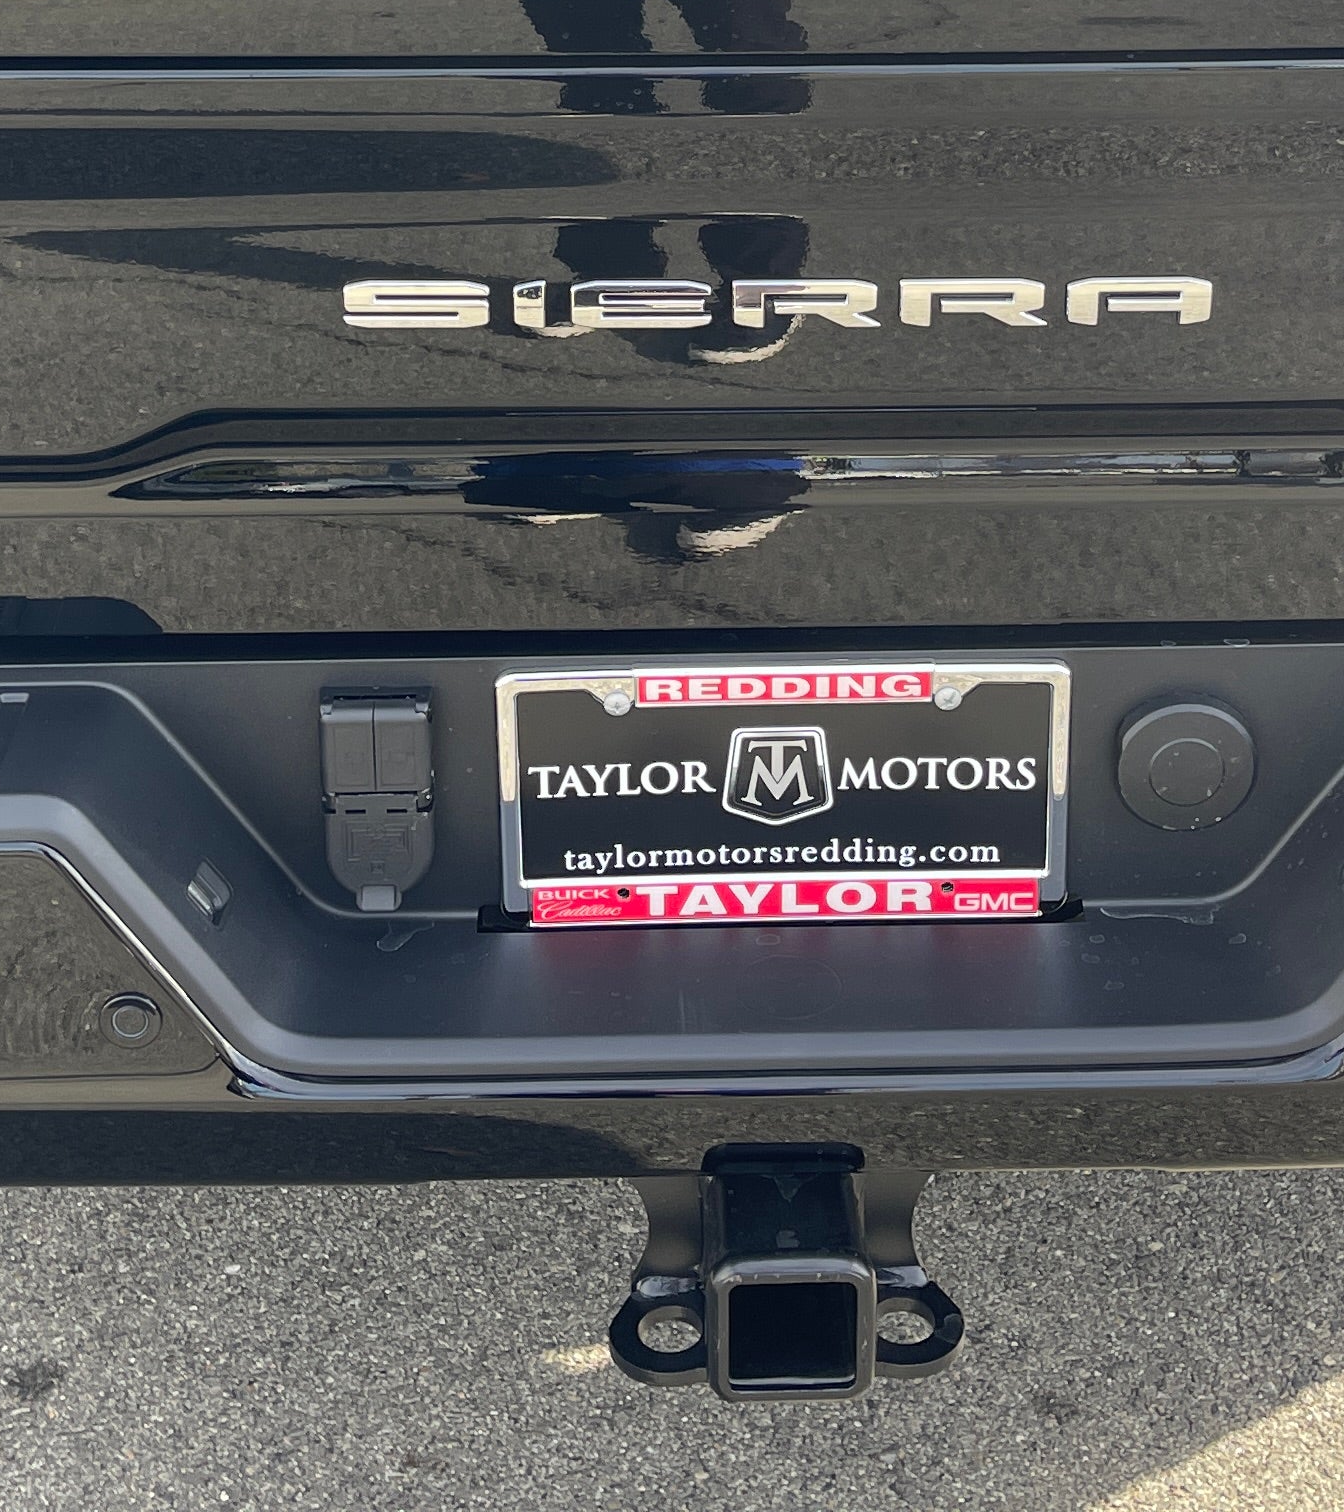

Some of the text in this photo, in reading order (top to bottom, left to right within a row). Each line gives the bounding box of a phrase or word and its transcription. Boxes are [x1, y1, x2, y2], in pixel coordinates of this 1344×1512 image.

[343, 277, 1213, 328] SIERRA
[644, 673, 923, 701] REDDING
[527, 760, 717, 799] TAYLOR
[836, 756, 1037, 791] MOTORS
[563, 837, 1001, 875] taylormotorsredding.com
[536, 900, 624, 921] Cadillac
[537, 888, 610, 901] BUICK
[635, 881, 933, 917] TAYLOR
[953, 891, 1034, 912] GMC
